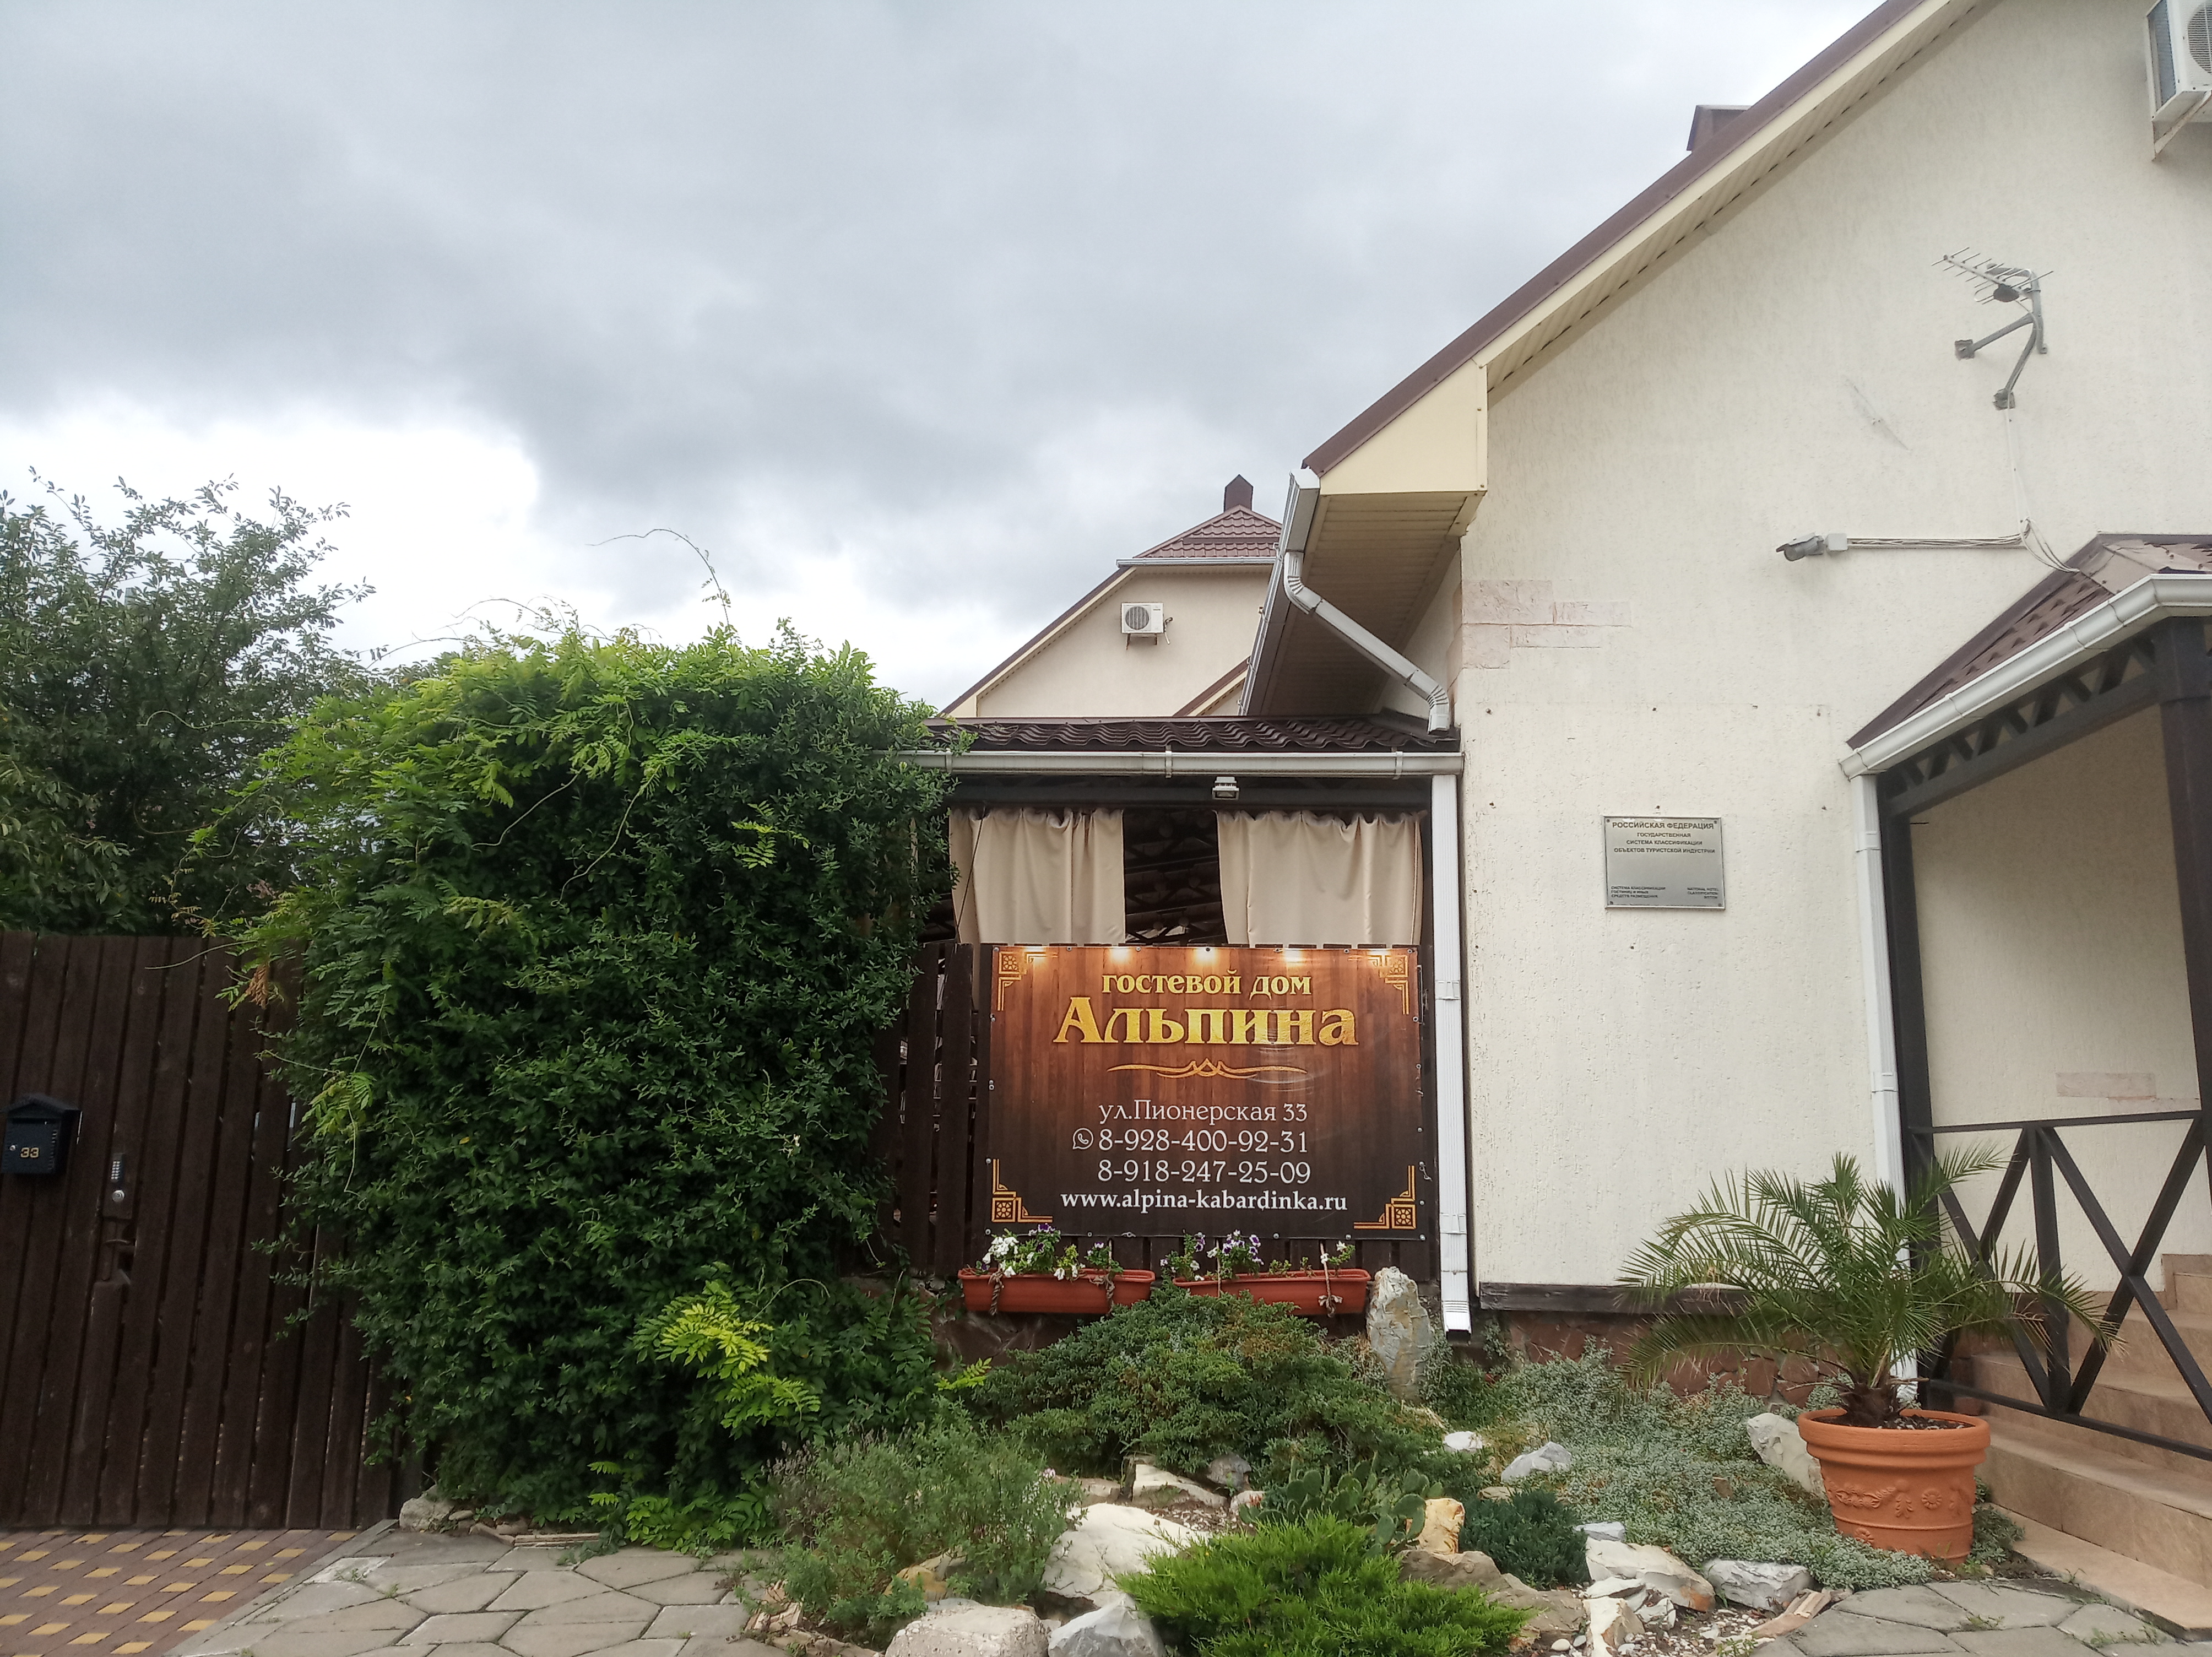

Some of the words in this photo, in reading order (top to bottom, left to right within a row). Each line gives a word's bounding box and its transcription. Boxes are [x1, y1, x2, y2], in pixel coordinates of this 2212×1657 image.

[1102, 968, 1241, 995] гостевой
[1249, 973, 1312, 1000] дом
[1053, 996, 1359, 1046] Альпина
[1098, 1100, 1276, 1125] ул.Пионерская
[1283, 1103, 1308, 1122] 33
[20, 1147, 39, 1158] 33
[1099, 1129, 1308, 1152] 8-928-400-92-31
[1098, 1160, 1311, 1183] 8-918-247-25-09
[1061, 1188, 1347, 1214] www.alpina-kabardinka.ru
